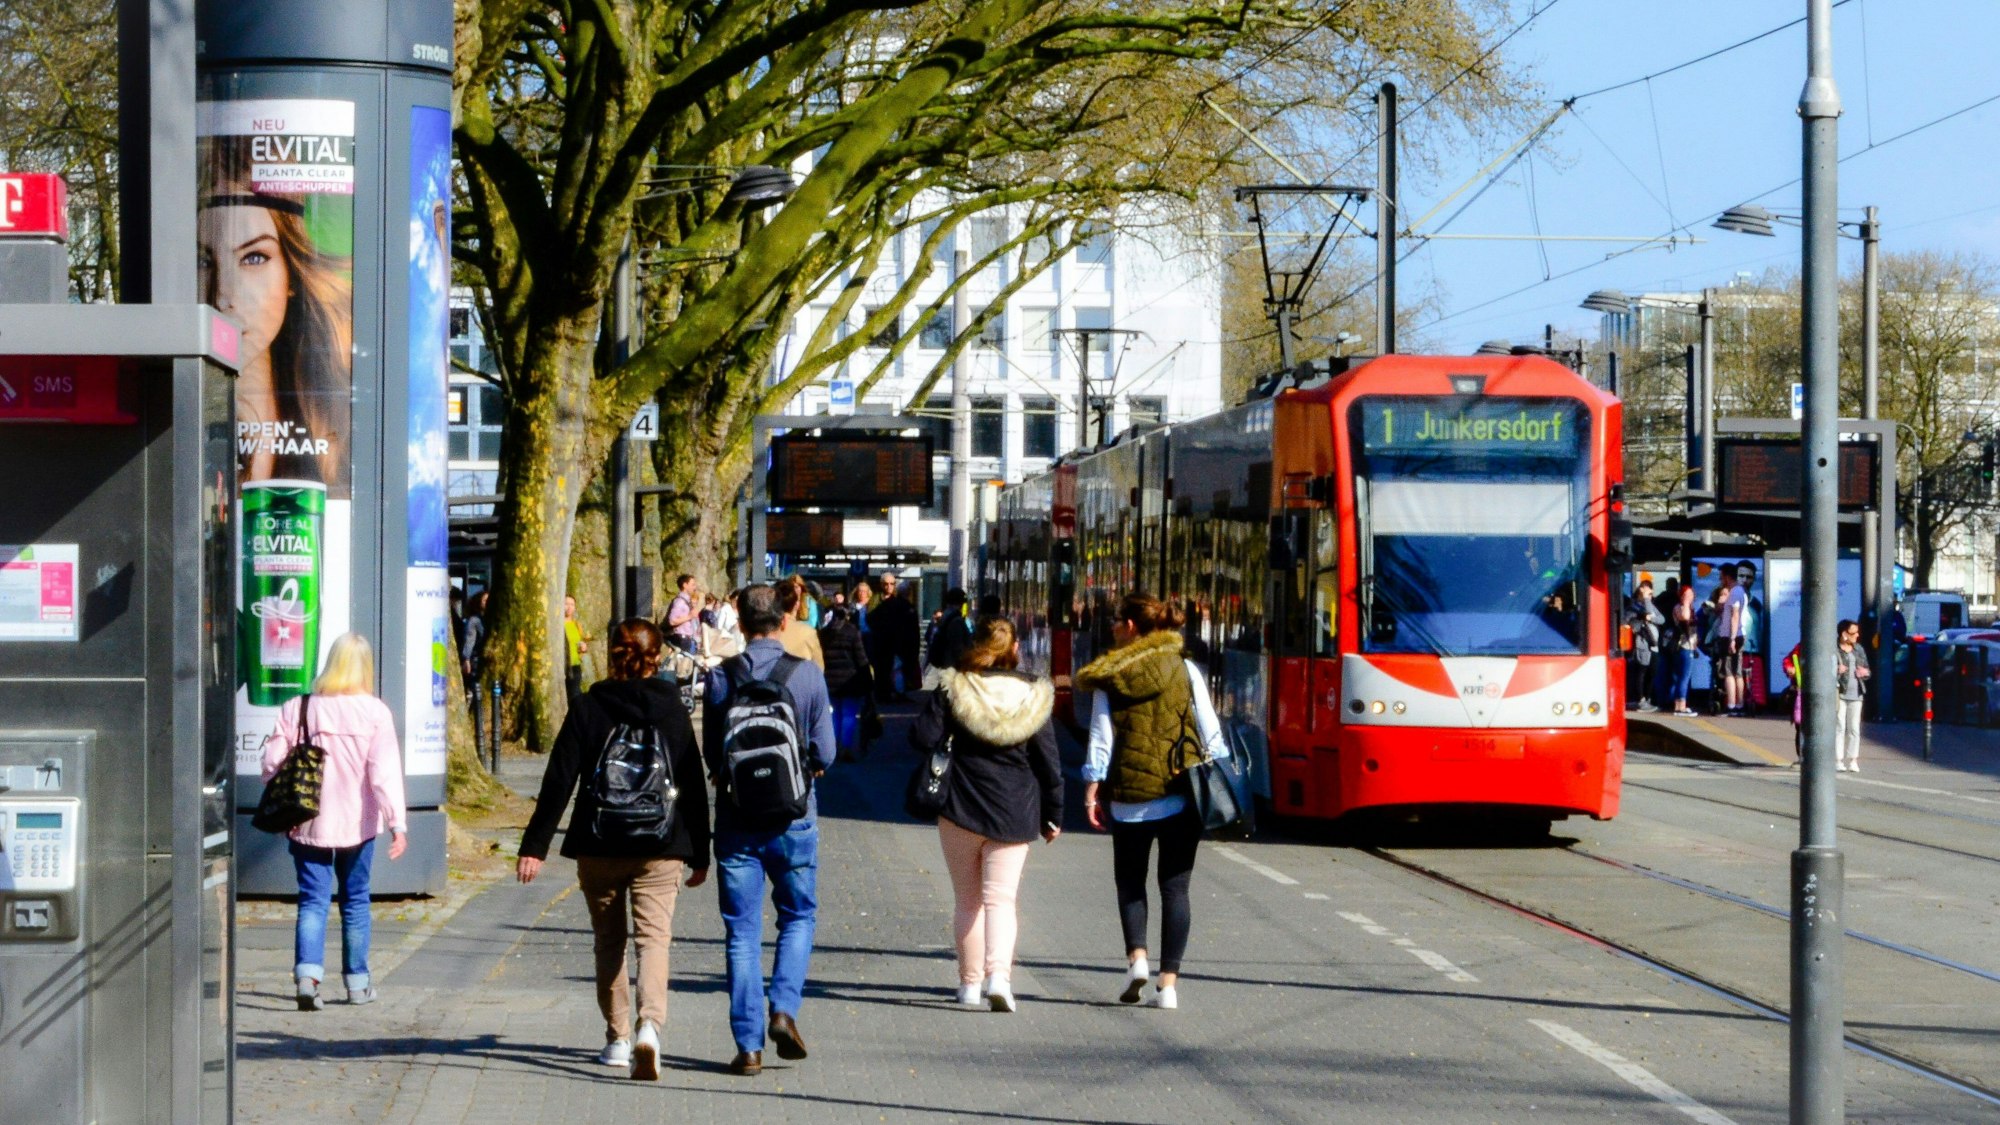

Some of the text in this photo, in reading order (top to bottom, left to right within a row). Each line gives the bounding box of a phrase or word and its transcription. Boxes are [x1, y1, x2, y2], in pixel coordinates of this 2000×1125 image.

[252, 119, 285, 131] NEU
[251, 136, 347, 162] ELVITAL
[258, 168, 346, 179] PLANTA CLEAR
[258, 182, 347, 193] ANTI-SCHUPPEN
[34, 376, 73, 393] SMS
[635, 414, 653, 435] 4
[1383, 408, 1562, 444] 1 Junkersdorf
[253, 534, 313, 552] ELVITAL
[1463, 686, 1484, 695] KVB
